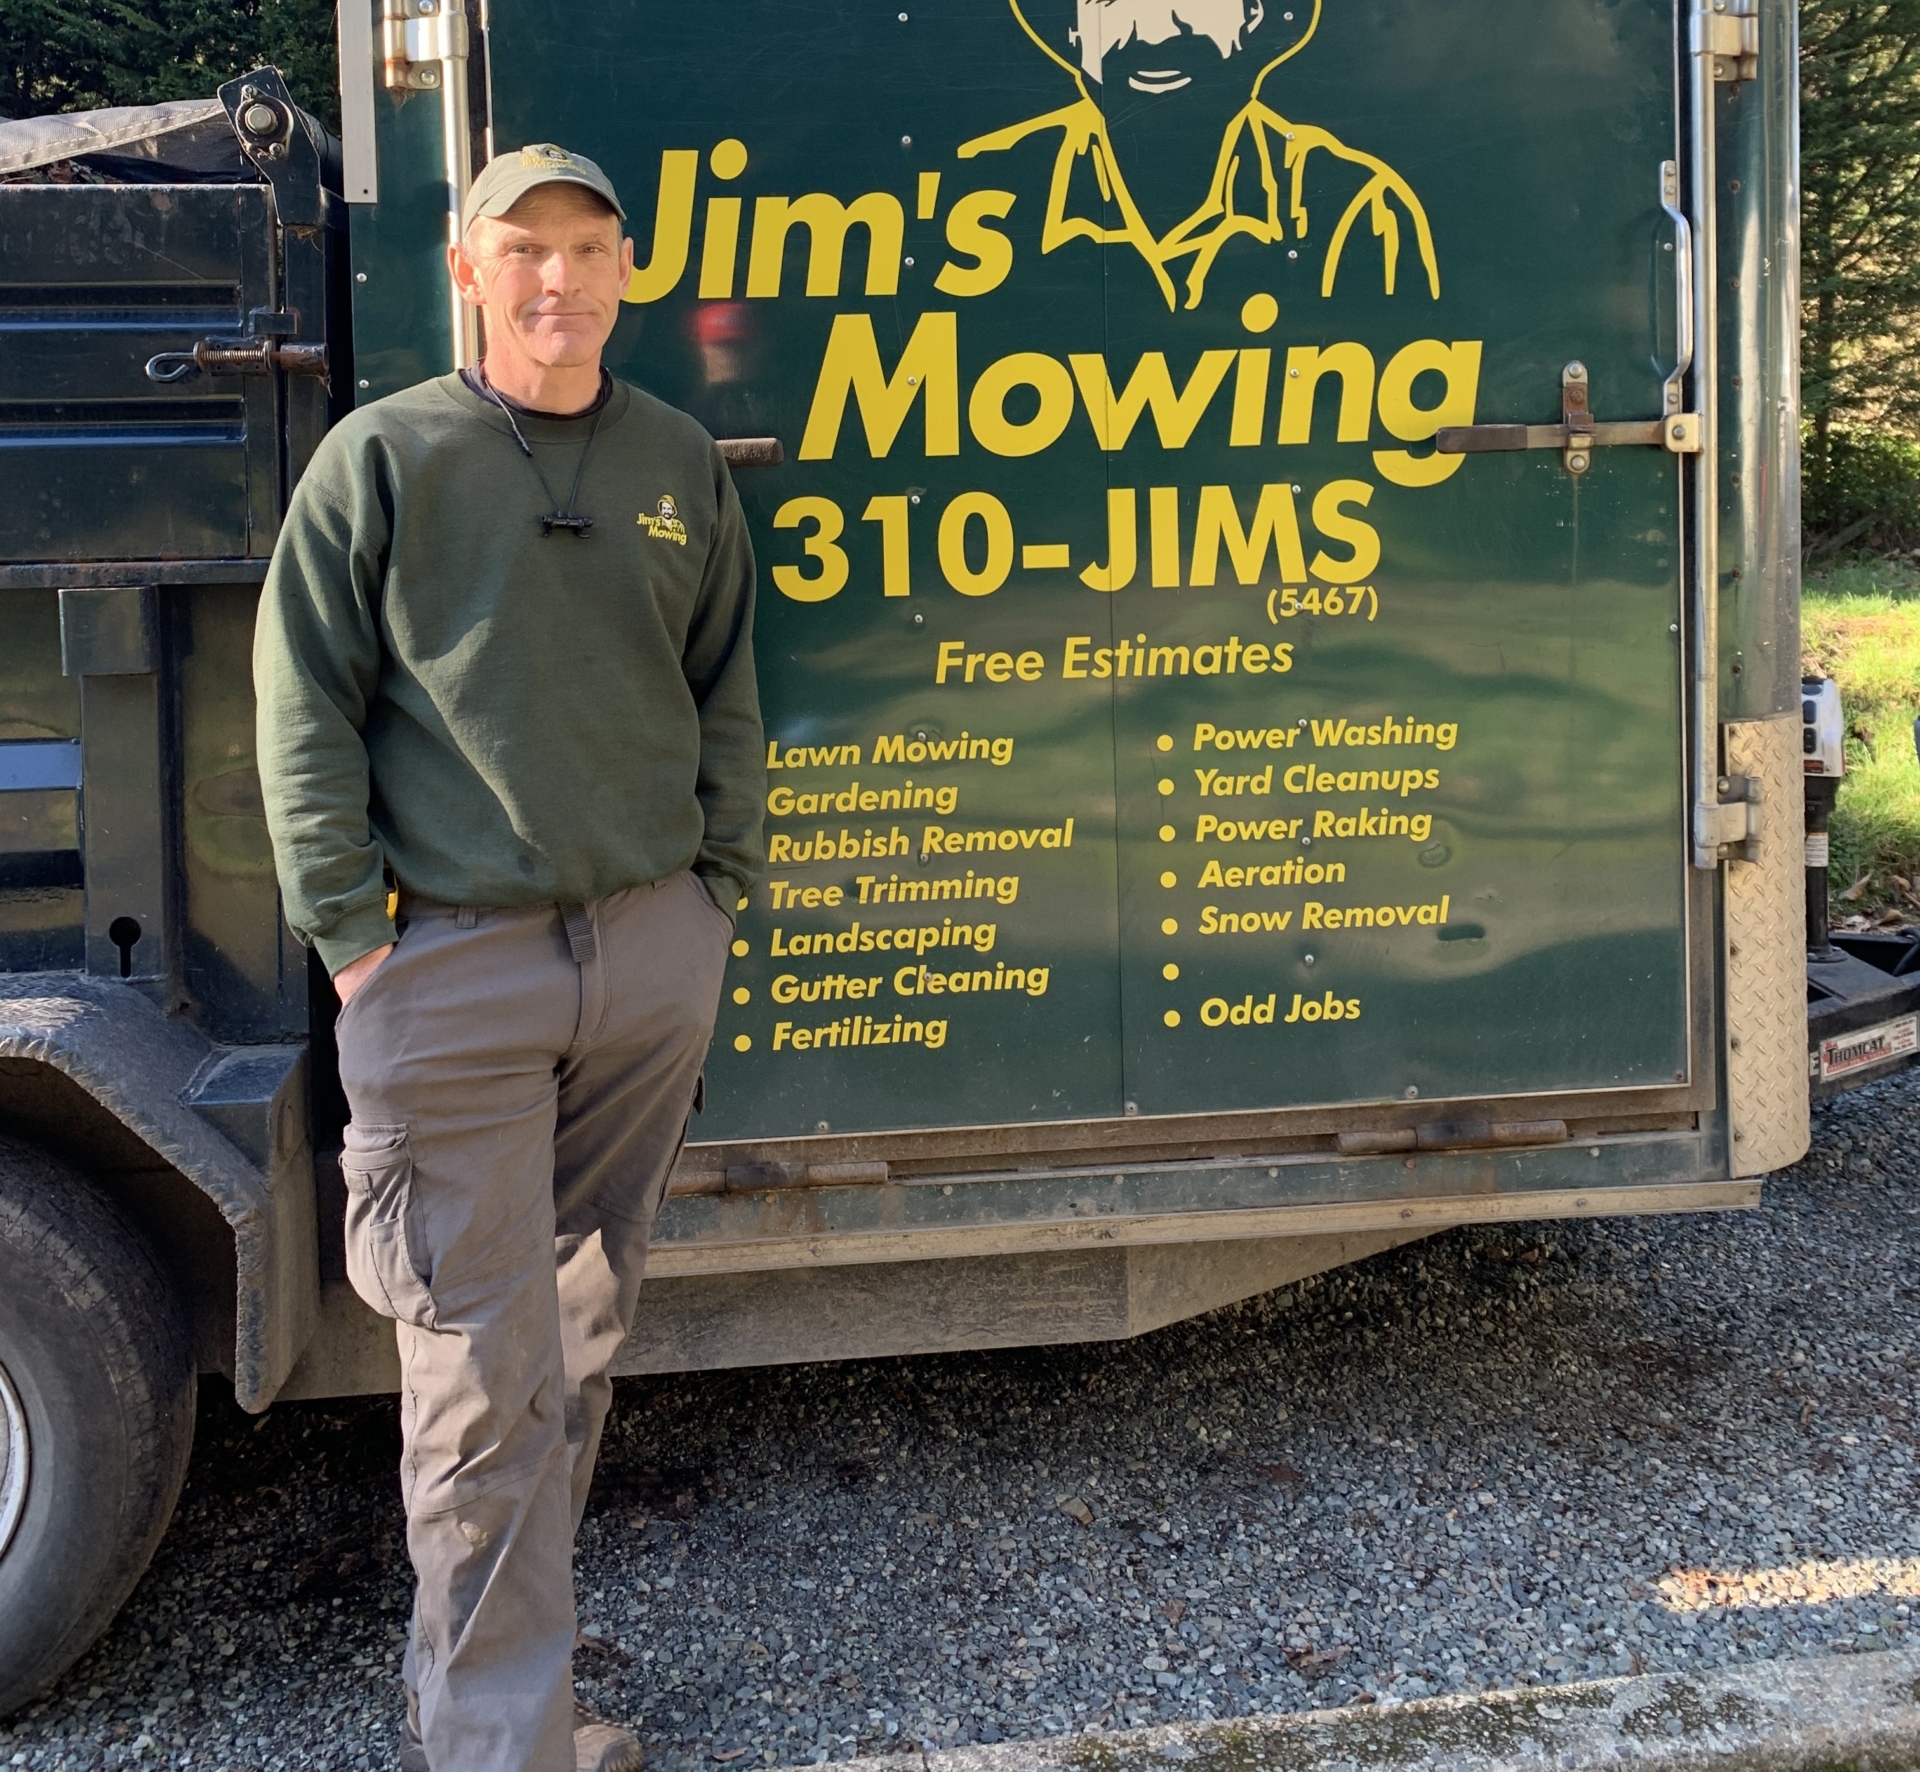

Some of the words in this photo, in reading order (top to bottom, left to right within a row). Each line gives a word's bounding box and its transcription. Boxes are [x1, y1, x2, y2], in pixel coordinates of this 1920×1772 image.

[620, 138, 1017, 304] Jim's
[797, 292, 1483, 488] Mowing
[636, 512, 661, 527] Jim's
[648, 525, 687, 546] Mowing
[771, 478, 1382, 602] 310-JIMS
[1266, 585, 1379, 625] (5467)
[935, 641, 1045, 684] Free
[1062, 633, 1293, 679] Estimates
[766, 741, 861, 769] Lawn
[872, 731, 1014, 766] Mowing
[1193, 722, 1301, 751] Power
[1310, 715, 1458, 751] Washing
[767, 779, 959, 816] Gardening
[1195, 764, 1274, 797] Yard
[1283, 763, 1440, 797] Cleanups
[768, 826, 910, 863] Rubbish
[921, 817, 1074, 854] Removal
[1195, 814, 1303, 843] Power
[1313, 807, 1433, 842] Raking
[769, 880, 843, 910] Tree
[856, 870, 1019, 905] Trimming
[1197, 856, 1346, 889] Aeration
[1199, 905, 1292, 935] Snow
[1302, 894, 1450, 930] Removal
[770, 917, 997, 957] Landscaping
[771, 974, 882, 1004] Gutter
[893, 962, 1049, 996] Cleaning
[1200, 994, 1276, 1027] Odd
[1285, 991, 1360, 1023] Jobs
[773, 1014, 947, 1051] Fertilizing
[1826, 1034, 1886, 1066] THOMCAT
